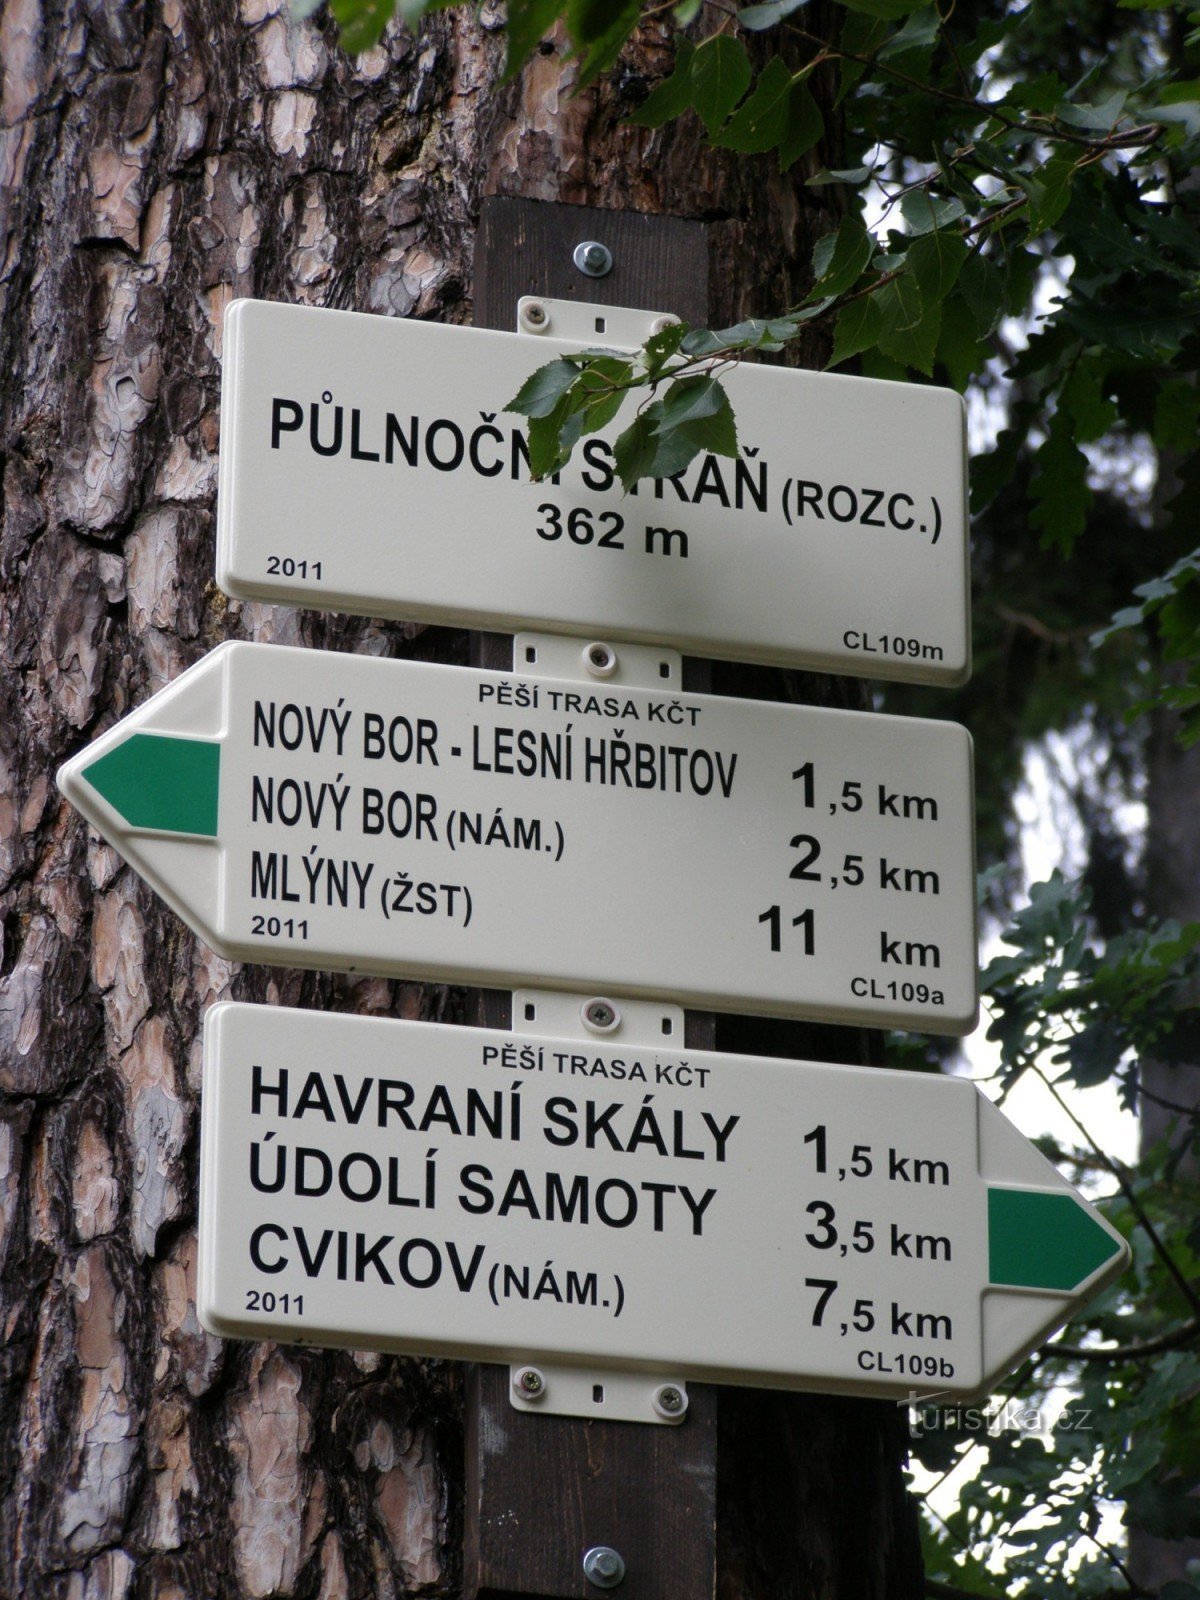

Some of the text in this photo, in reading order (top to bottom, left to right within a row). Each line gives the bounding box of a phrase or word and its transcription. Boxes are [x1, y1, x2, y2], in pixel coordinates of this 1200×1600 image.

[271, 390, 562, 486] PŮLNOČN
[781, 477, 942, 545] (ROZC.)
[536, 503, 689, 559] 362 m
[266, 556, 322, 581] 2011
[842, 630, 944, 661] CL109m
[478, 681, 702, 727] PĚŠÍ TRASA KČT
[253, 700, 352, 756] NOVÝ
[363, 712, 440, 767] BOR
[472, 724, 572, 781] LESNÍ
[584, 727, 739, 799] HŘBITOV
[791, 761, 864, 817] 1,5
[877, 783, 939, 822] km
[251, 772, 940, 895] NOVÝ BOR (NÁM.) 2,5 km
[251, 850, 941, 969] MLÝNY (ŽST) 11 km
[251, 915, 308, 940] 2011
[850, 976, 945, 1006] CL109a
[482, 1043, 711, 1089] PĚŠÍ TRASA KČT
[251, 1065, 950, 1186] HAVRANÍ SKÁLY 1,5 km
[249, 1131, 952, 1262] ÚDOLÍ SAMOTY 3,5 km
[245, 1290, 303, 1316] 2011
[249, 1223, 953, 1341] CVIKOV (NÁM.) 7,5 km
[857, 1349, 955, 1379] CL109b
